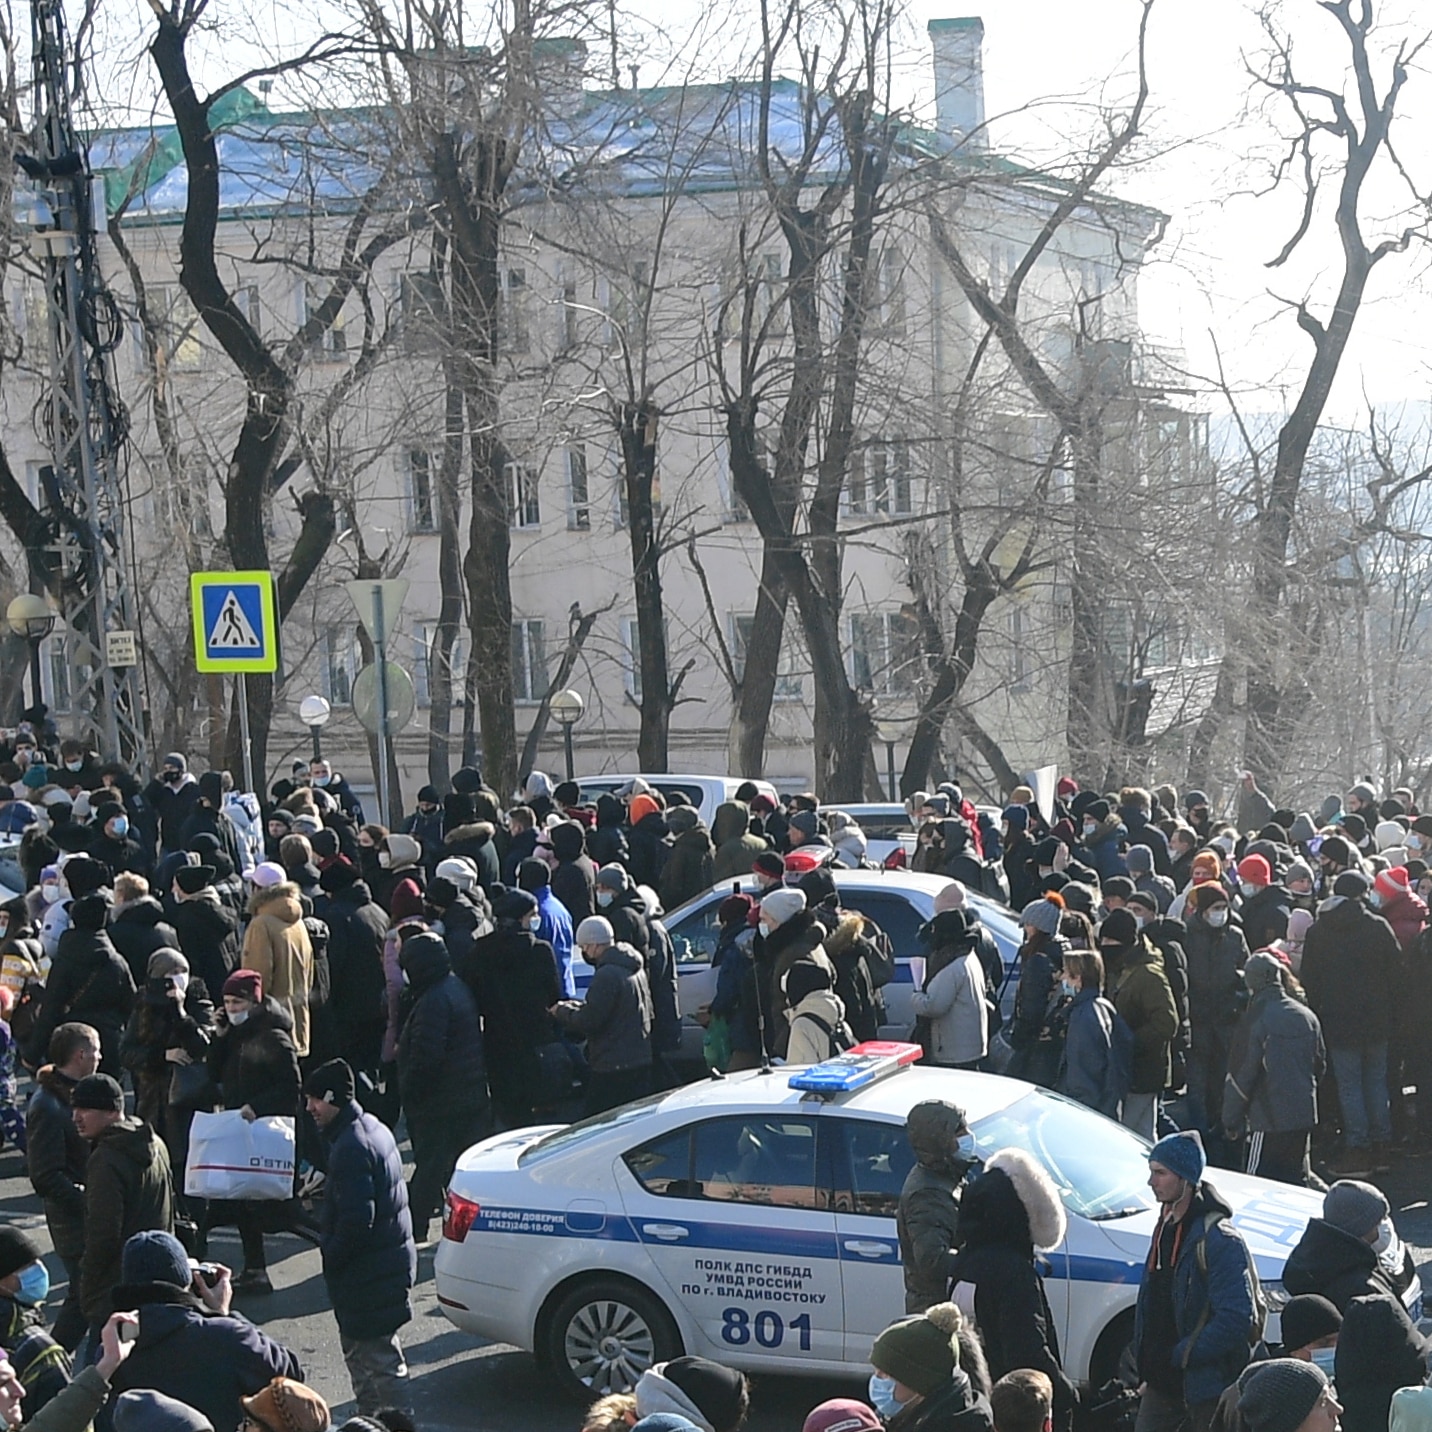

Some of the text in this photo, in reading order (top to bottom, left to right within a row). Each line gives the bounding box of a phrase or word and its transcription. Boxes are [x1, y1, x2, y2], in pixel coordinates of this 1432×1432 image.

[480, 1210, 564, 1224] ТЕЛЕФОН ДОВЕРИЯ
[695, 1259, 812, 1279] ПОЛК ДПС ГИБДД
[706, 1273, 803, 1290] УМВД РОССИИ
[681, 1284, 826, 1304] ПО г. ВЛАДИВОСТОКУ
[721, 1307, 811, 1351] 801
